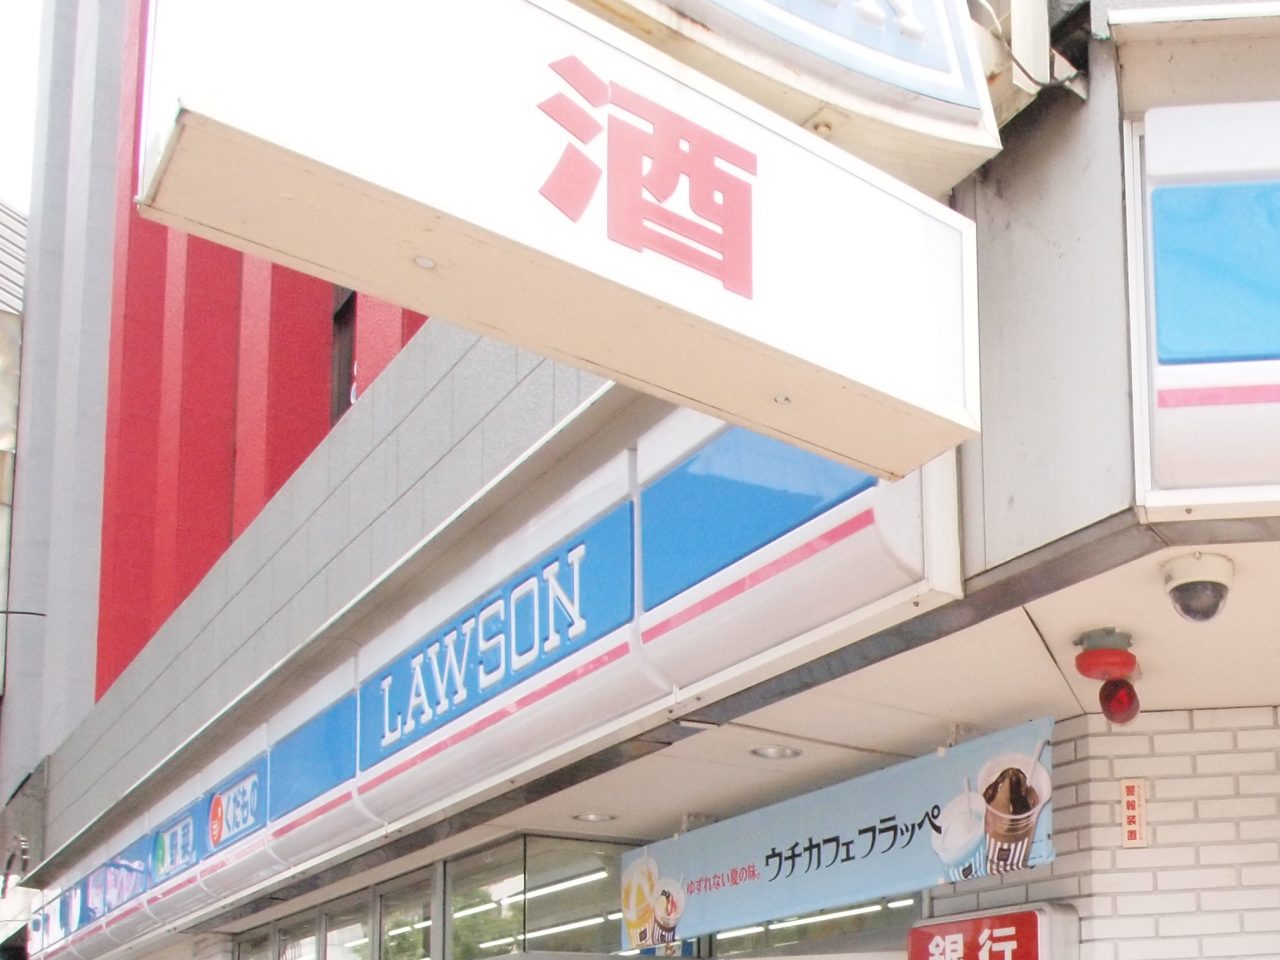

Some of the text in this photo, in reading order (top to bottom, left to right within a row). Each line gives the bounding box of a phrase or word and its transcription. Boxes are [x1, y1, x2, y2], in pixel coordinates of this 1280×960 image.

[537, 55, 757, 299] 酒
[381, 544, 586, 747] LAWSON
[765, 804, 942, 881] ウチカフェフラッペ
